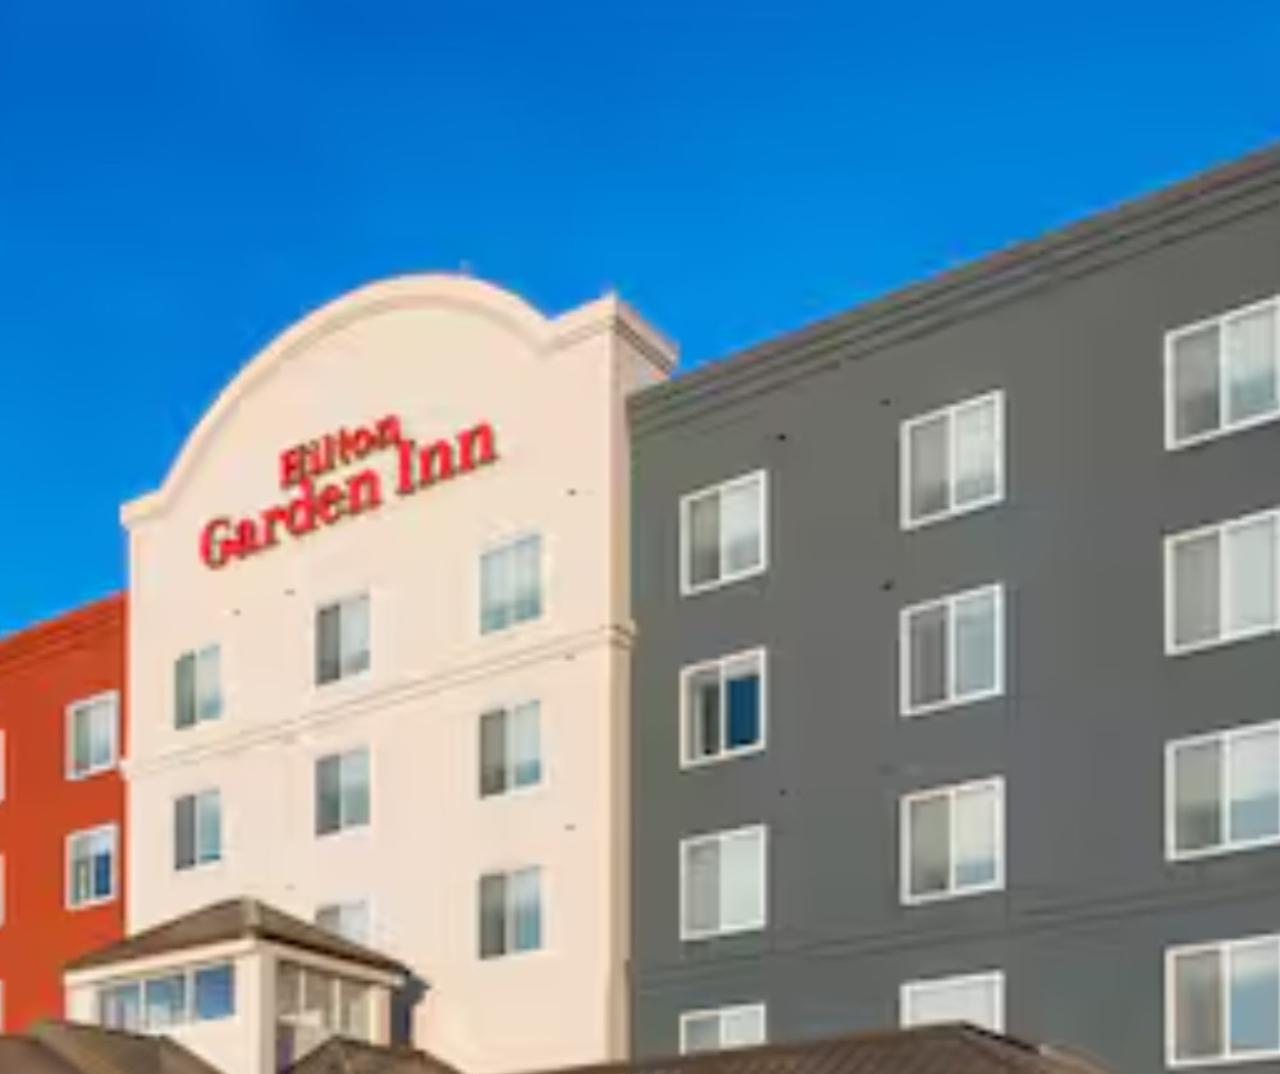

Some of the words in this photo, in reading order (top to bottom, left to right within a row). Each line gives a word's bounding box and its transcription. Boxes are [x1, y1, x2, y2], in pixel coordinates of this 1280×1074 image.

[199, 467, 383, 569] Garden
[395, 421, 498, 495] Inn
[279, 414, 402, 490] Hilton
